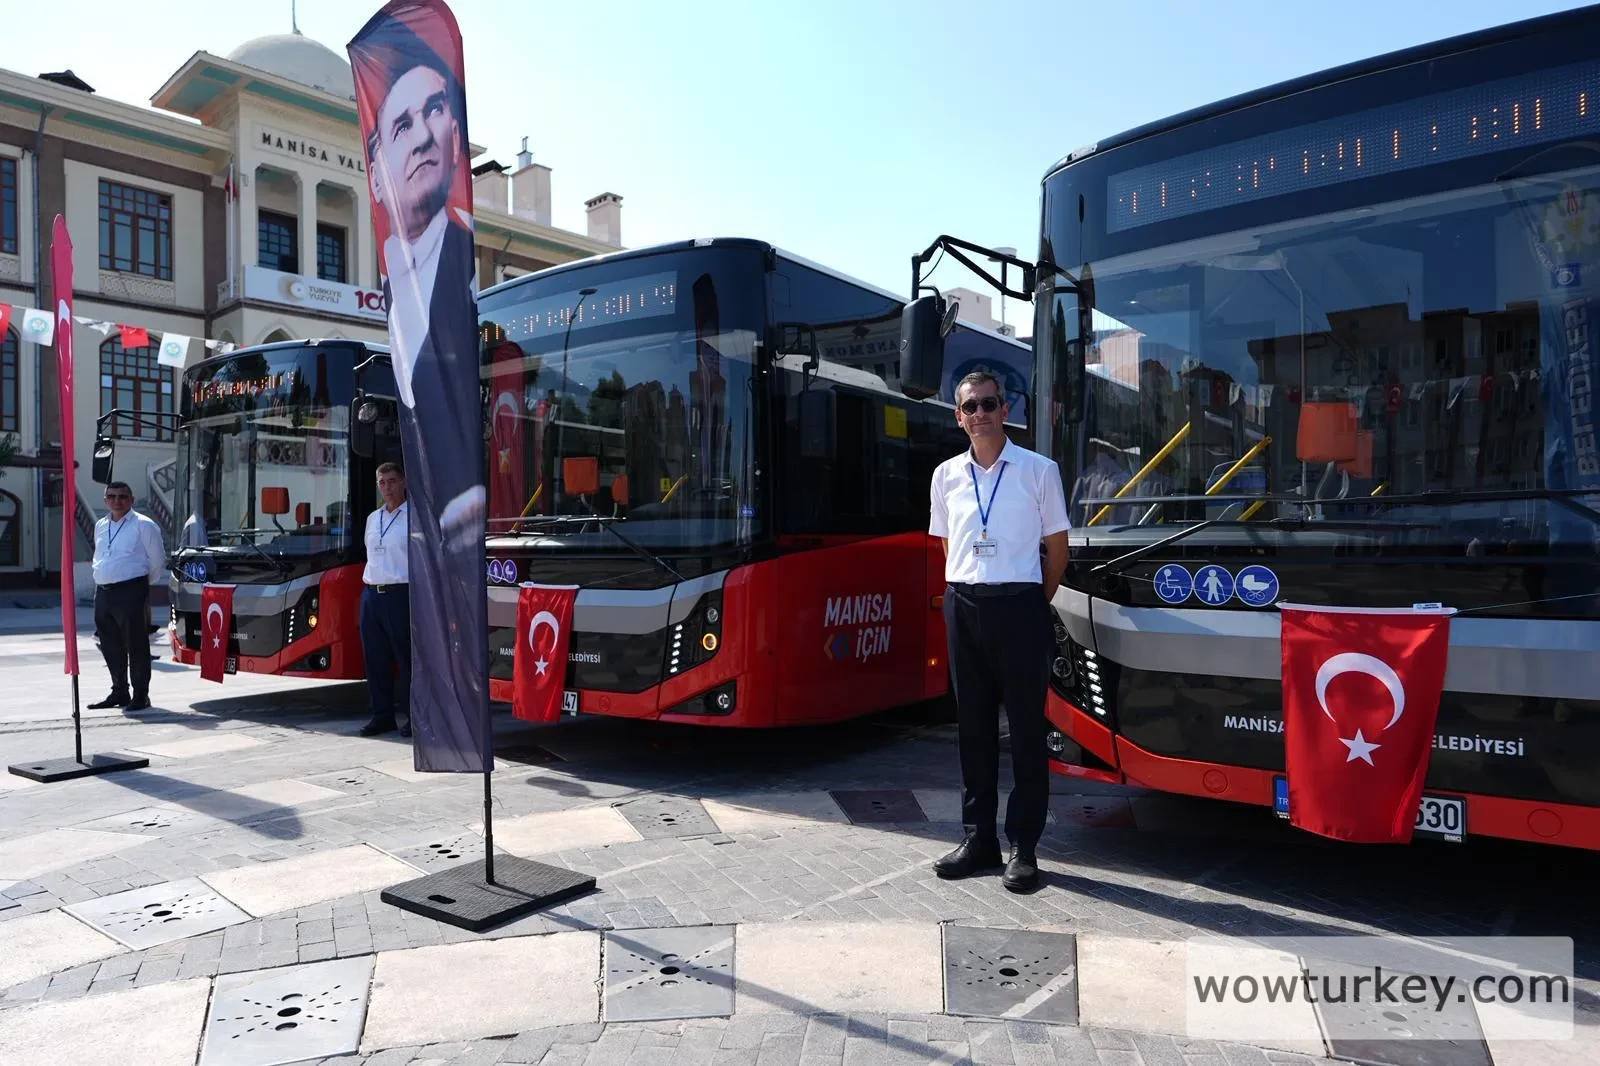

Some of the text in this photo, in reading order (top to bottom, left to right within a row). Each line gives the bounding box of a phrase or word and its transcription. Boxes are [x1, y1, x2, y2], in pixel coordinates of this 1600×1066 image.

[262, 132, 328, 161] MANİSA
[824, 592, 892, 627] MANİSA
[855, 625, 892, 663] İÇİN
